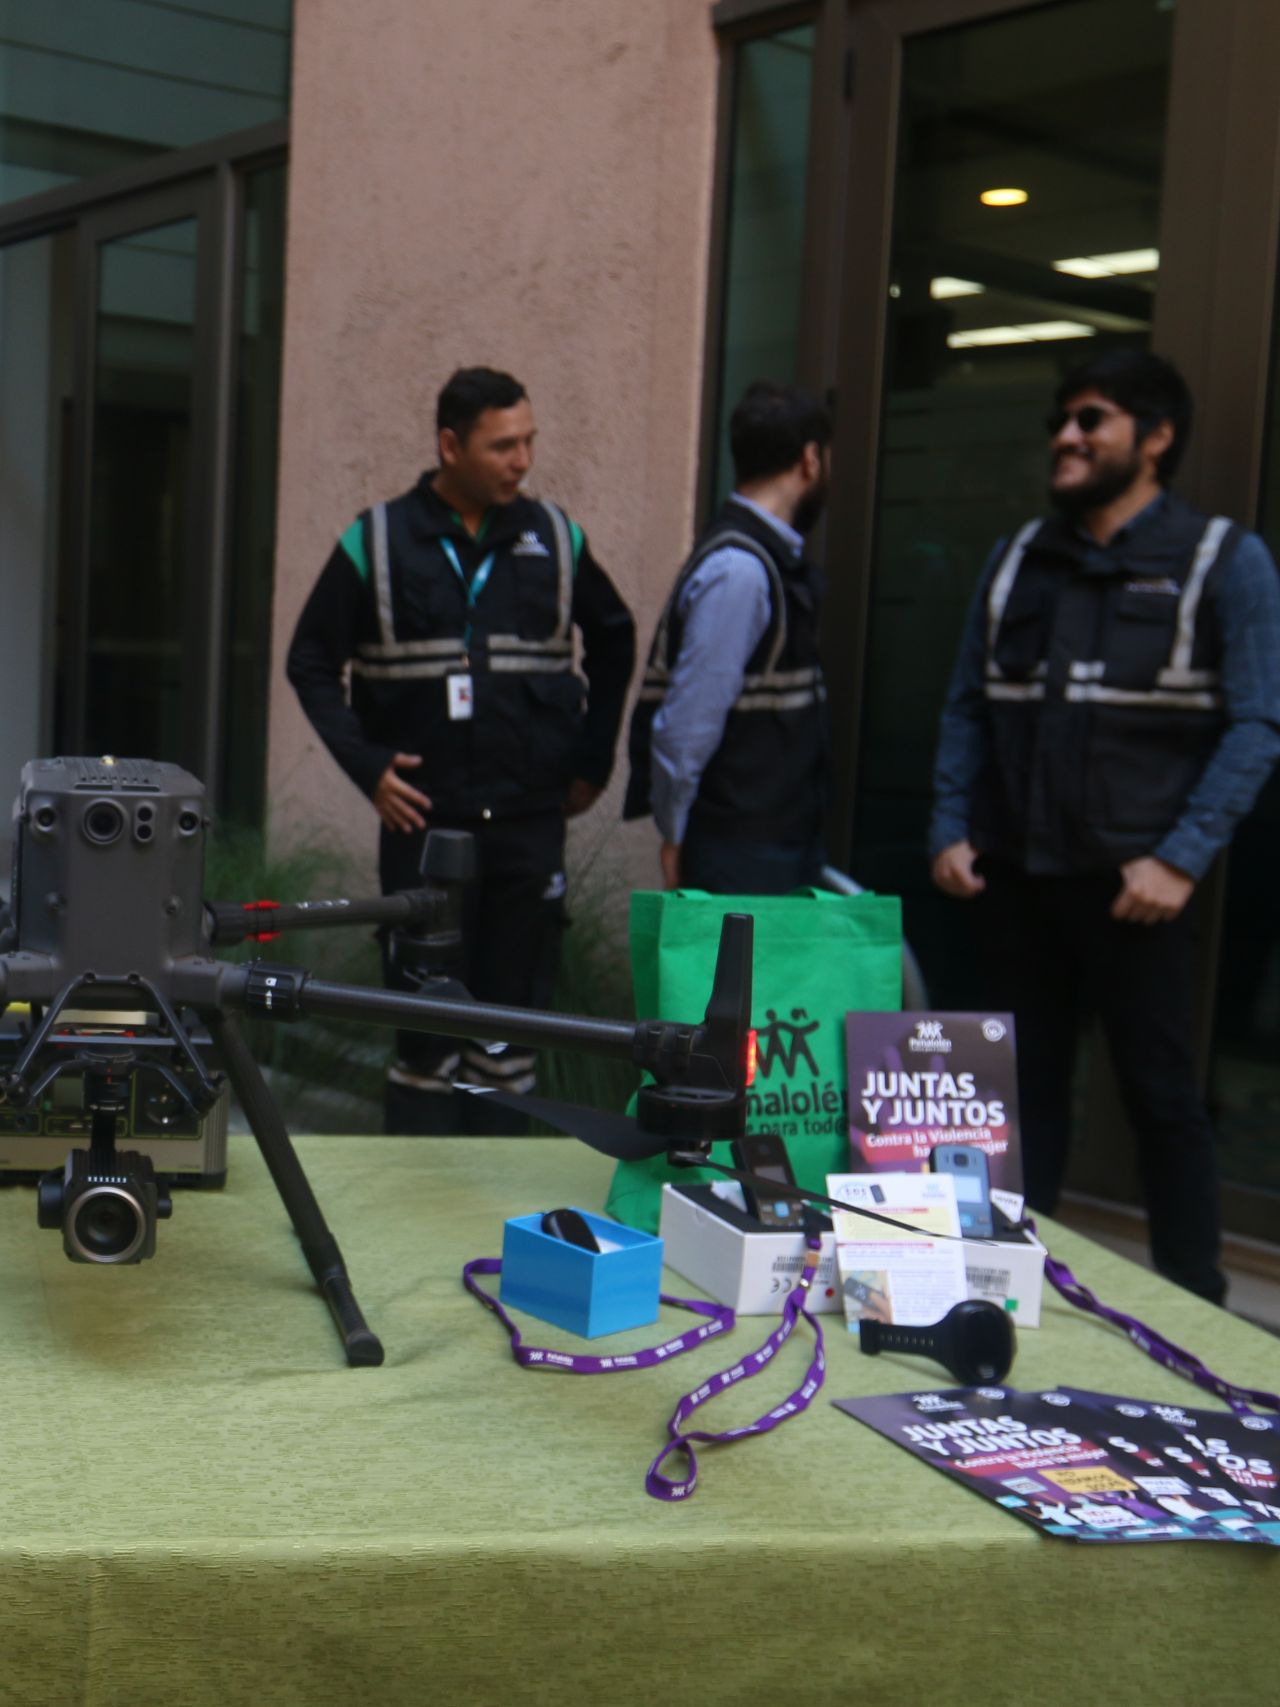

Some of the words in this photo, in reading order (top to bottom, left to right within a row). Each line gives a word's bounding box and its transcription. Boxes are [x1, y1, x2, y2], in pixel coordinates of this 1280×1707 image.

[861, 1070, 976, 1099] JUNTAS
[746, 1081, 848, 1118] ñalolé
[862, 1099, 883, 1125] Y
[888, 1100, 1006, 1127] JUNTOS
[866, 1132, 913, 1148] Contra
[913, 1130, 928, 1145] la
[929, 1127, 993, 1144] Violencia
[902, 1415, 1028, 1442] JUNTAS
[919, 1439, 951, 1456] Y
[953, 1427, 1082, 1455] JUNTOS
